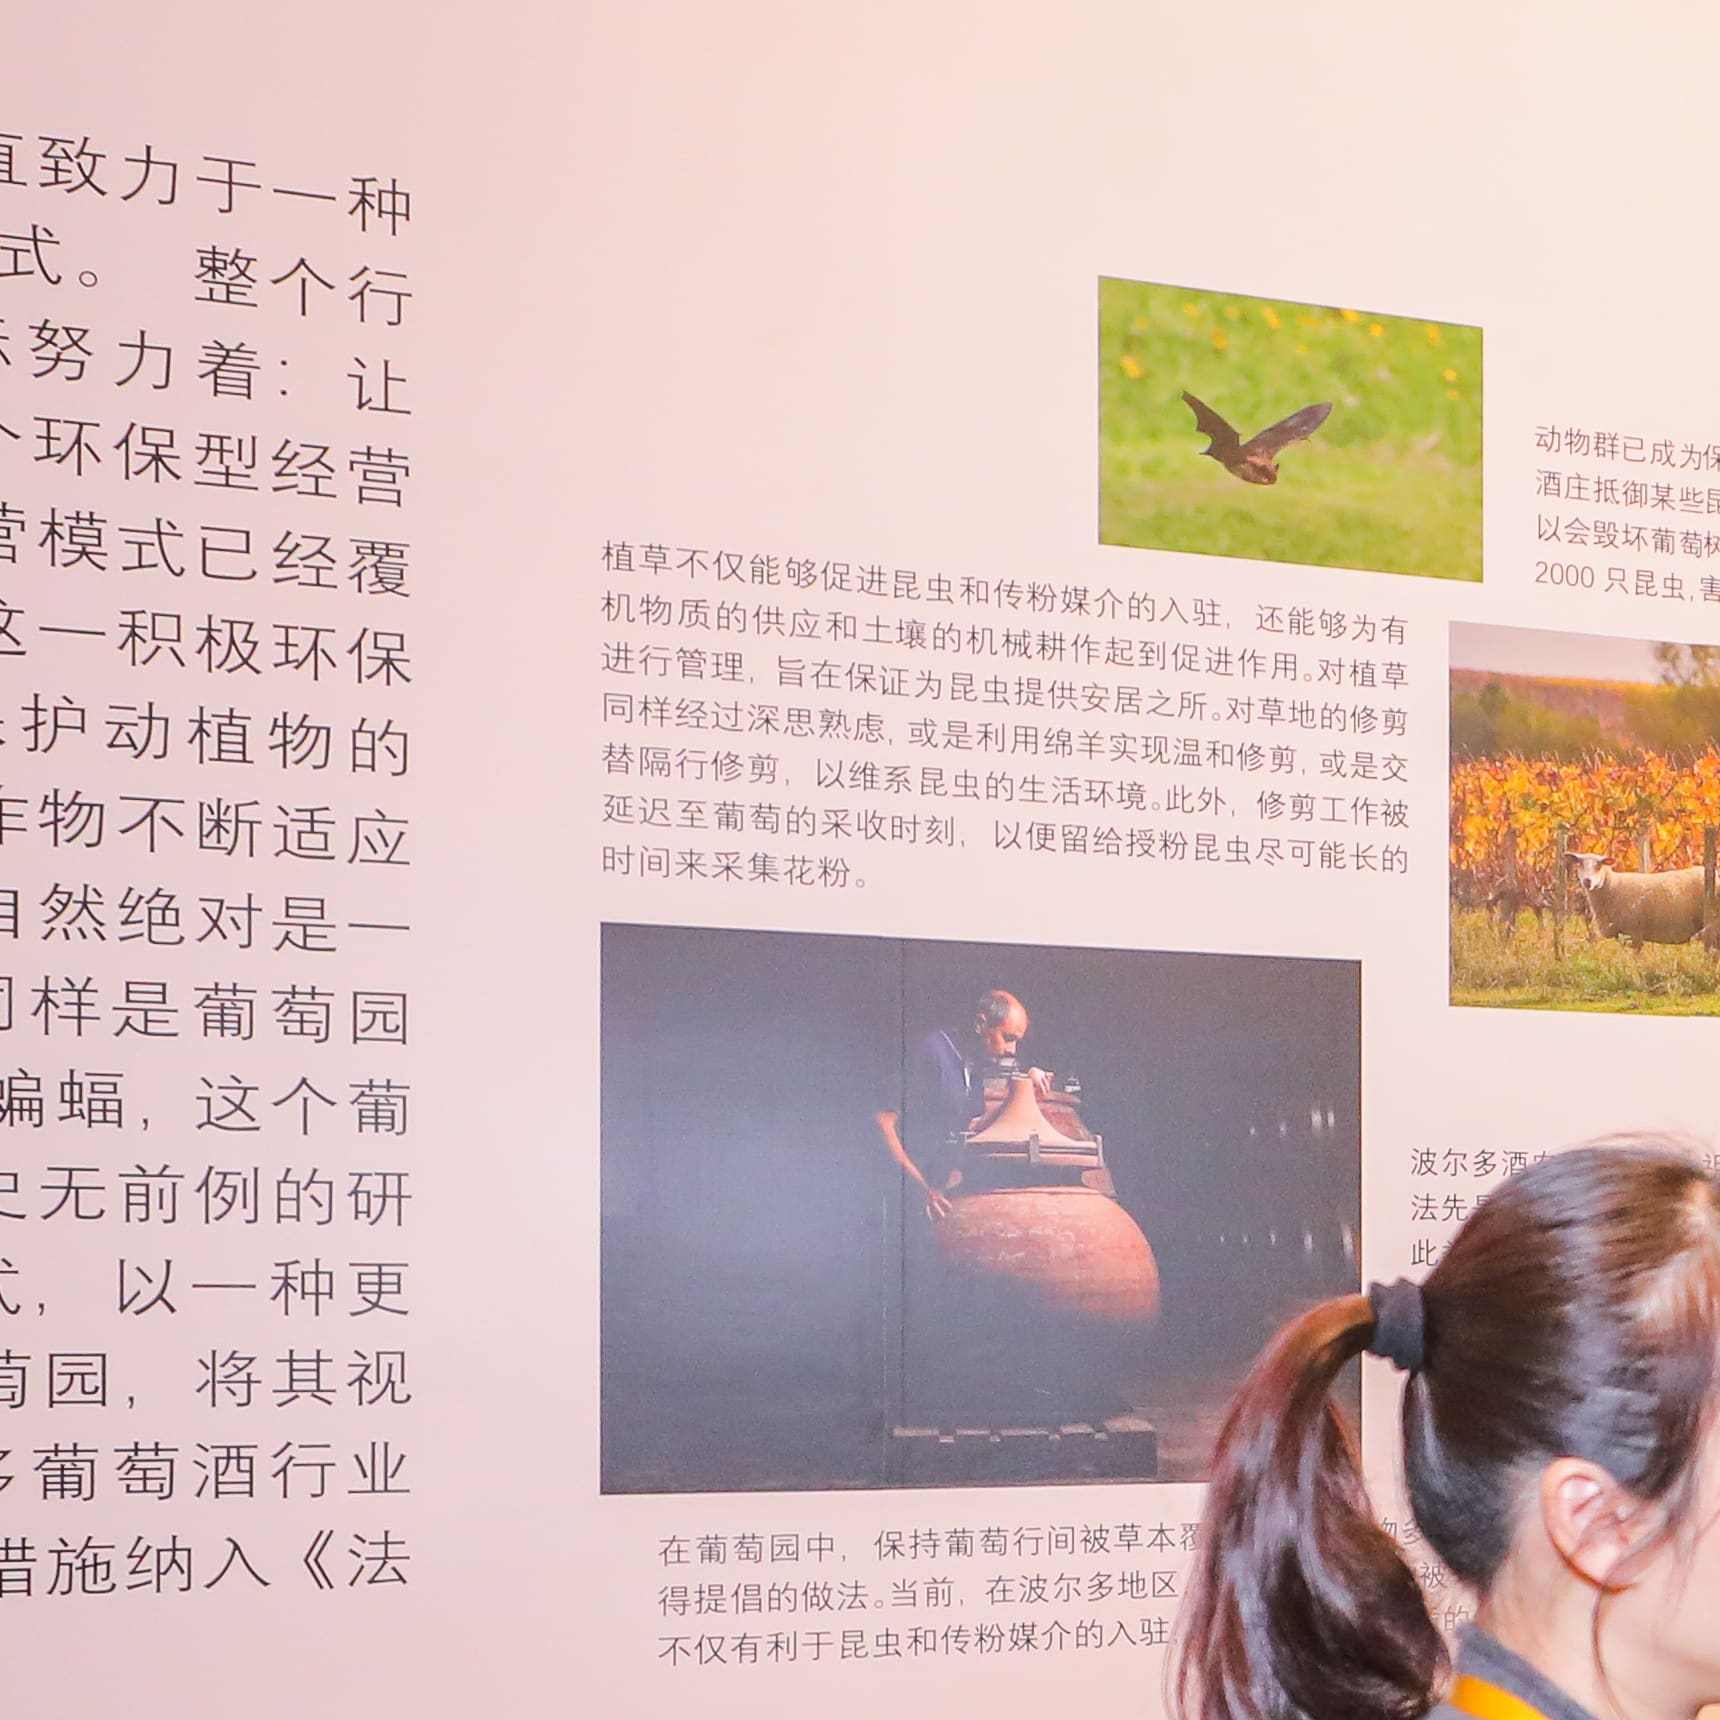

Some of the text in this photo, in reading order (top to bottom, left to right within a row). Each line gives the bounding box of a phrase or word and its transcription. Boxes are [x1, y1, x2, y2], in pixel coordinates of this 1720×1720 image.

[0, 317, 411, 416] 努力着：让
[1535, 560, 1595, 589] 2000
[0, 692, 411, 776] 护动植物的
[601, 845, 867, 888] 时间来采集花粉。
[0, 975, 411, 1046] 样是葡萄园
[1411, 1193, 1490, 1222] 法先
[1411, 1239, 1454, 1267] 此
[0, 1440, 411, 1502] 葡萄酒行业
